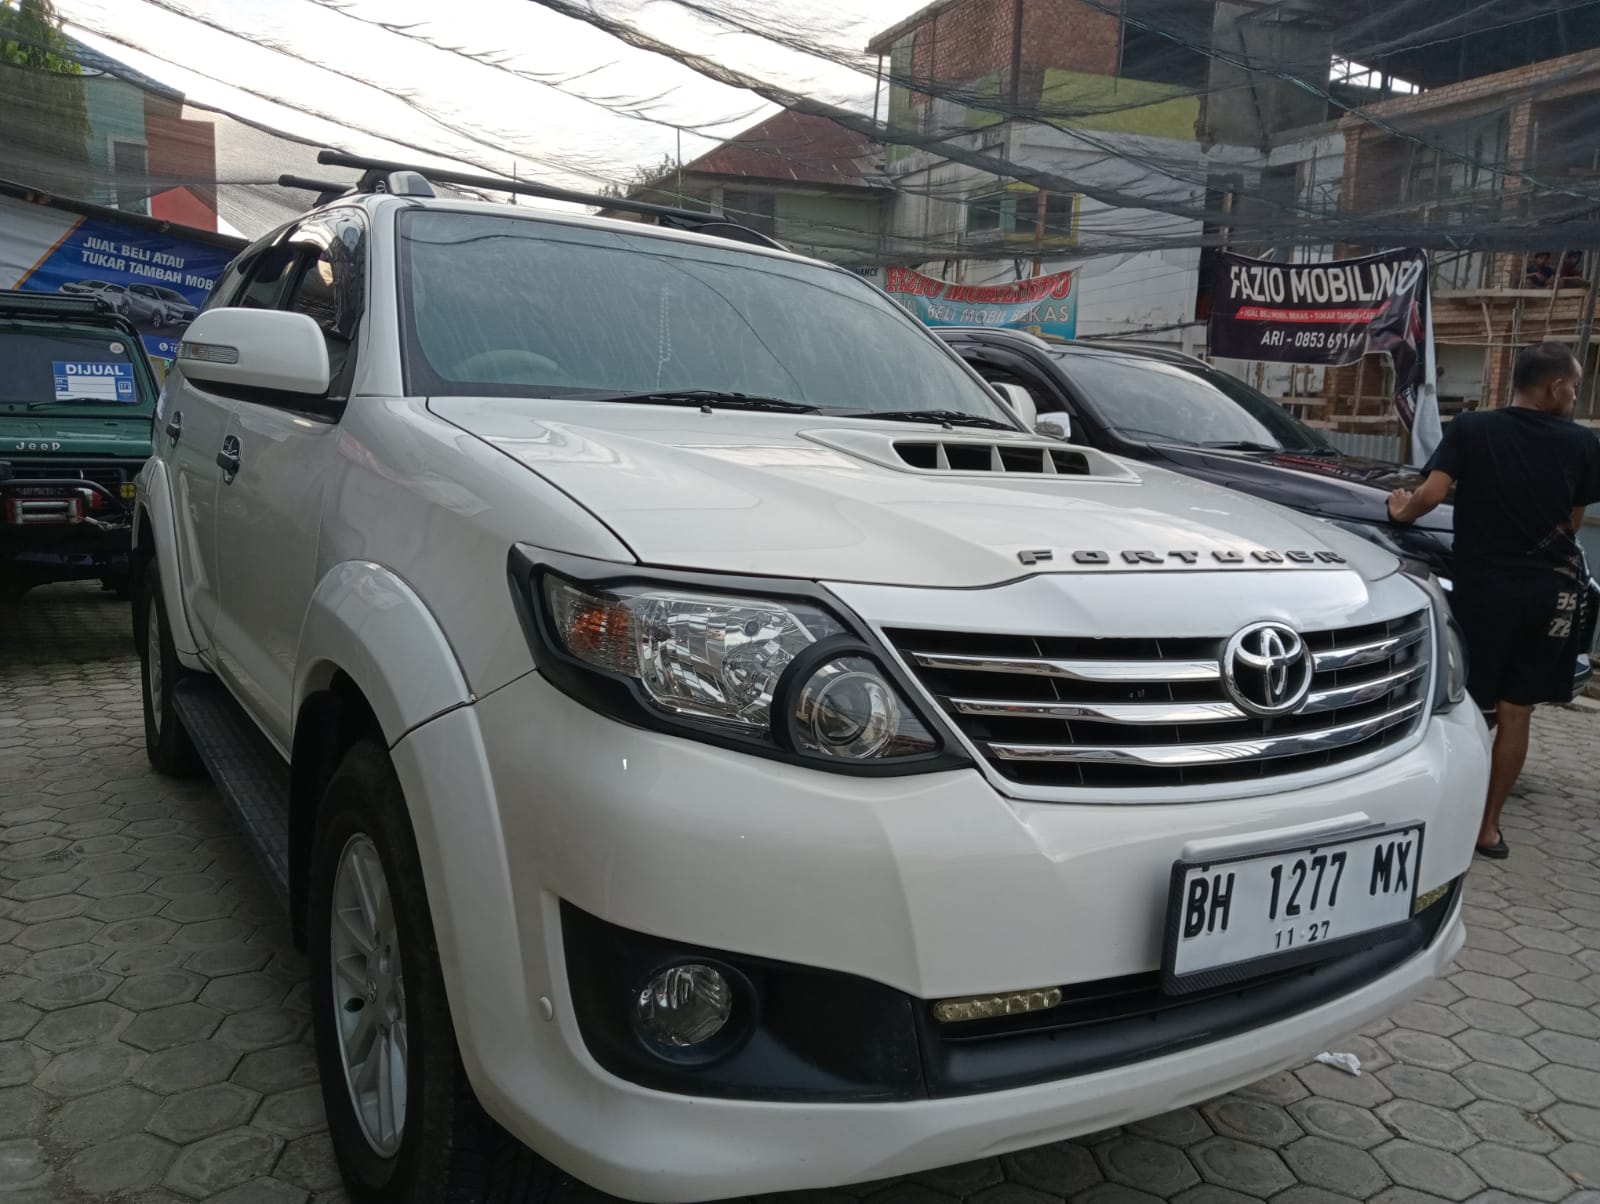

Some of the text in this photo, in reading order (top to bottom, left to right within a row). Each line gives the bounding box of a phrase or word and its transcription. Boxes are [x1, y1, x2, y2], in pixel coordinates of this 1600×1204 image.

[83, 236, 185, 269] JUAL BELI ATAU
[81, 251, 217, 291] TUKAR TAMBAH MOB
[1230, 266, 1286, 303] FAZIO
[1011, 305, 1070, 322] BEKAS
[1260, 330, 1284, 347] ARI
[1294, 331, 1325, 348] 0853
[65, 364, 124, 376] DIJUAL
[1017, 549, 1347, 565] FORTUNER
[1183, 840, 1412, 938] BH 1277 MX
[1275, 920, 1330, 949] 11 27
